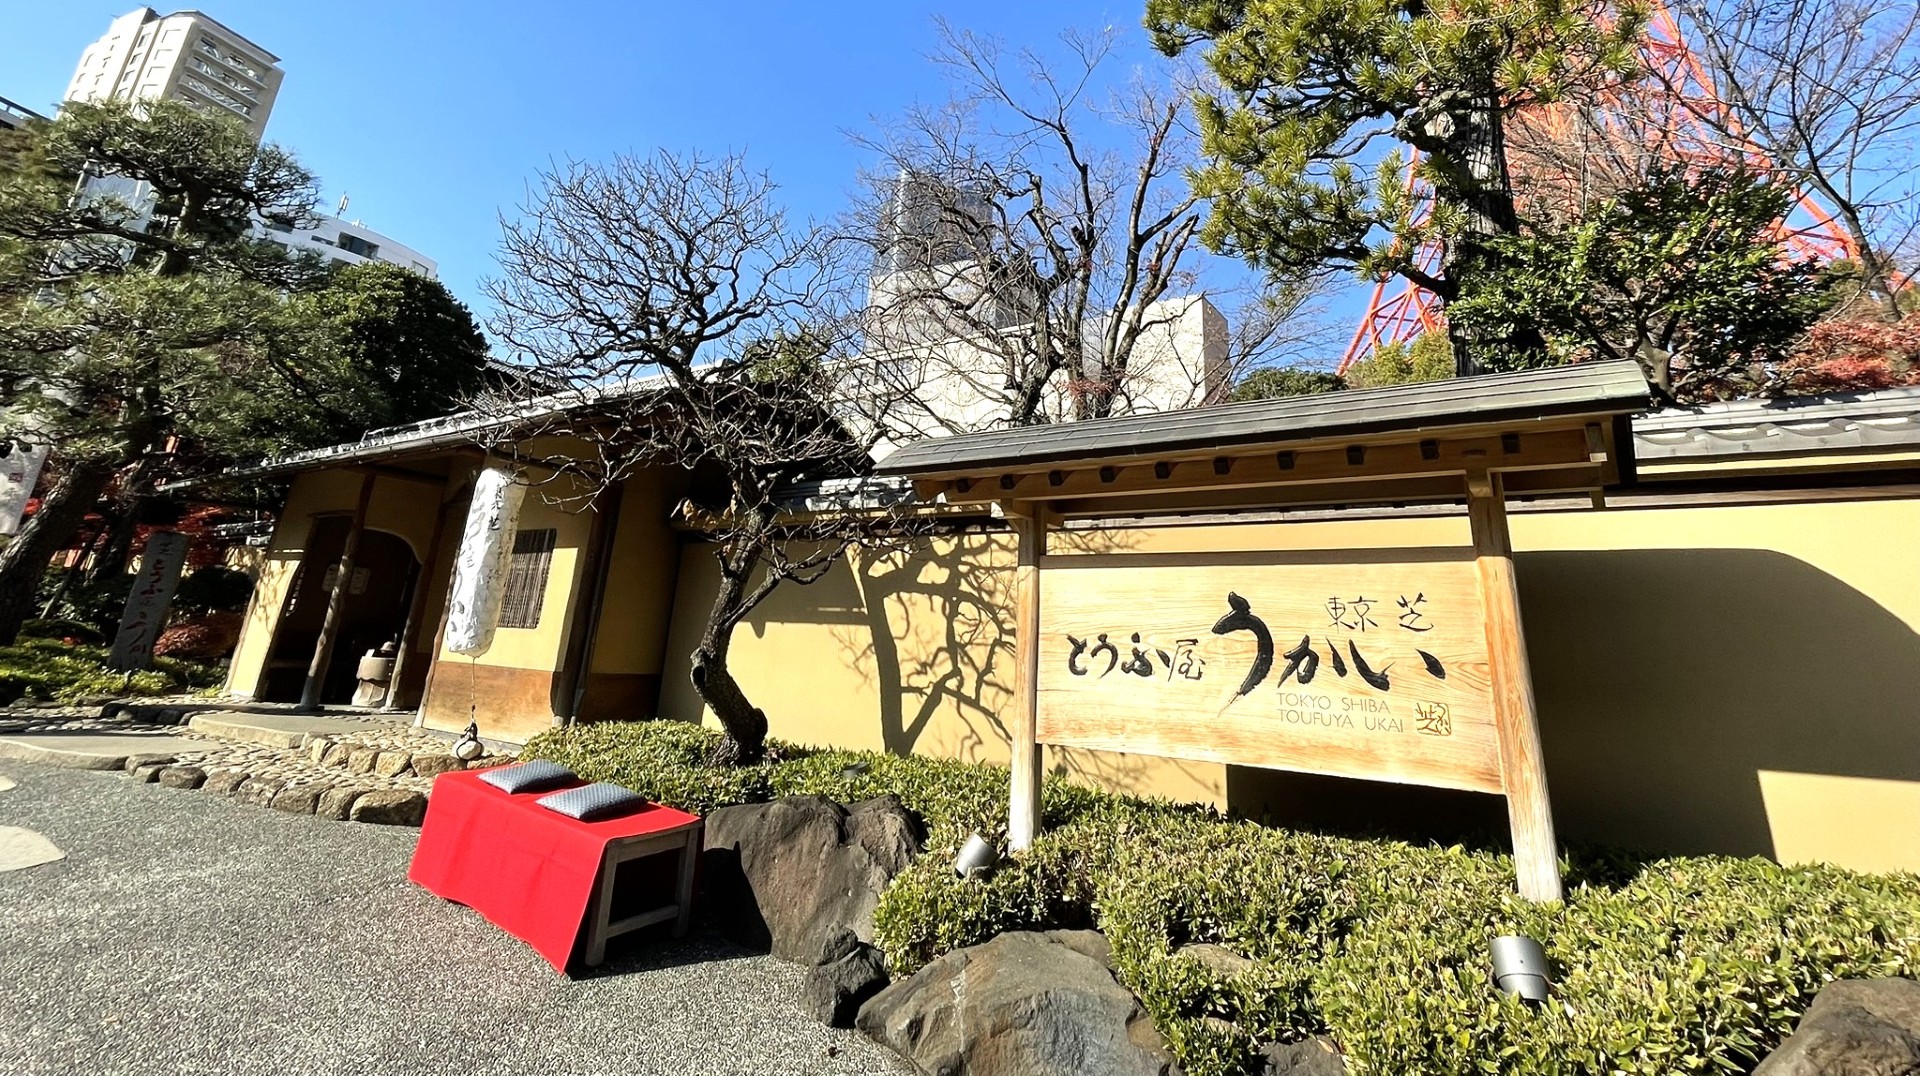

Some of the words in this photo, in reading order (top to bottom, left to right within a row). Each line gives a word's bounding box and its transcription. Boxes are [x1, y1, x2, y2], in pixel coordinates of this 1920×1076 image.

[1324, 595, 1378, 634] 東京
[1396, 592, 1434, 632] 芝
[1276, 692, 1331, 709] TOKYO
[1342, 697, 1391, 714] SHIBA
[1277, 709, 1355, 729] TOUFUYA
[1364, 716, 1404, 733] UKAI
